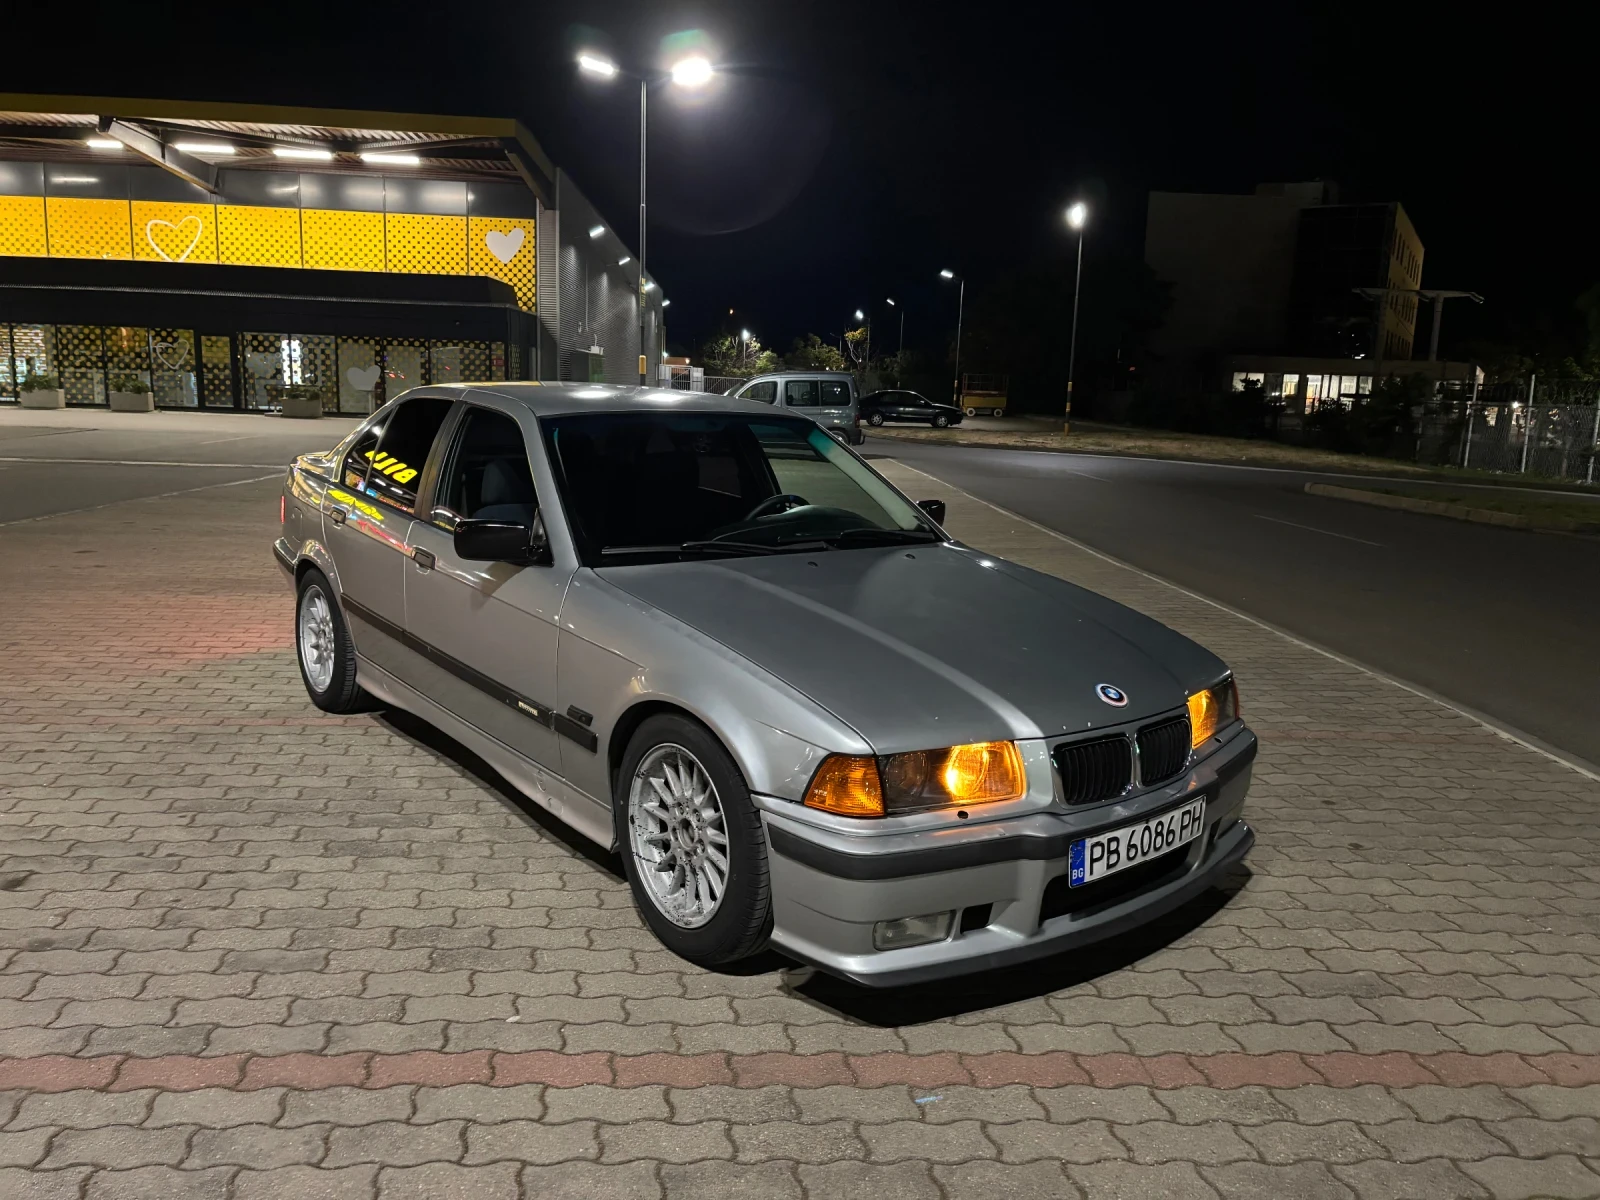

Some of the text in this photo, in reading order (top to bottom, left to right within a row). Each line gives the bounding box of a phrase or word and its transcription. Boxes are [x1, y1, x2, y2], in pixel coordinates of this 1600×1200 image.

[1089, 803, 1203, 876] PB 6086 PH
[1072, 868, 1084, 880] BG
